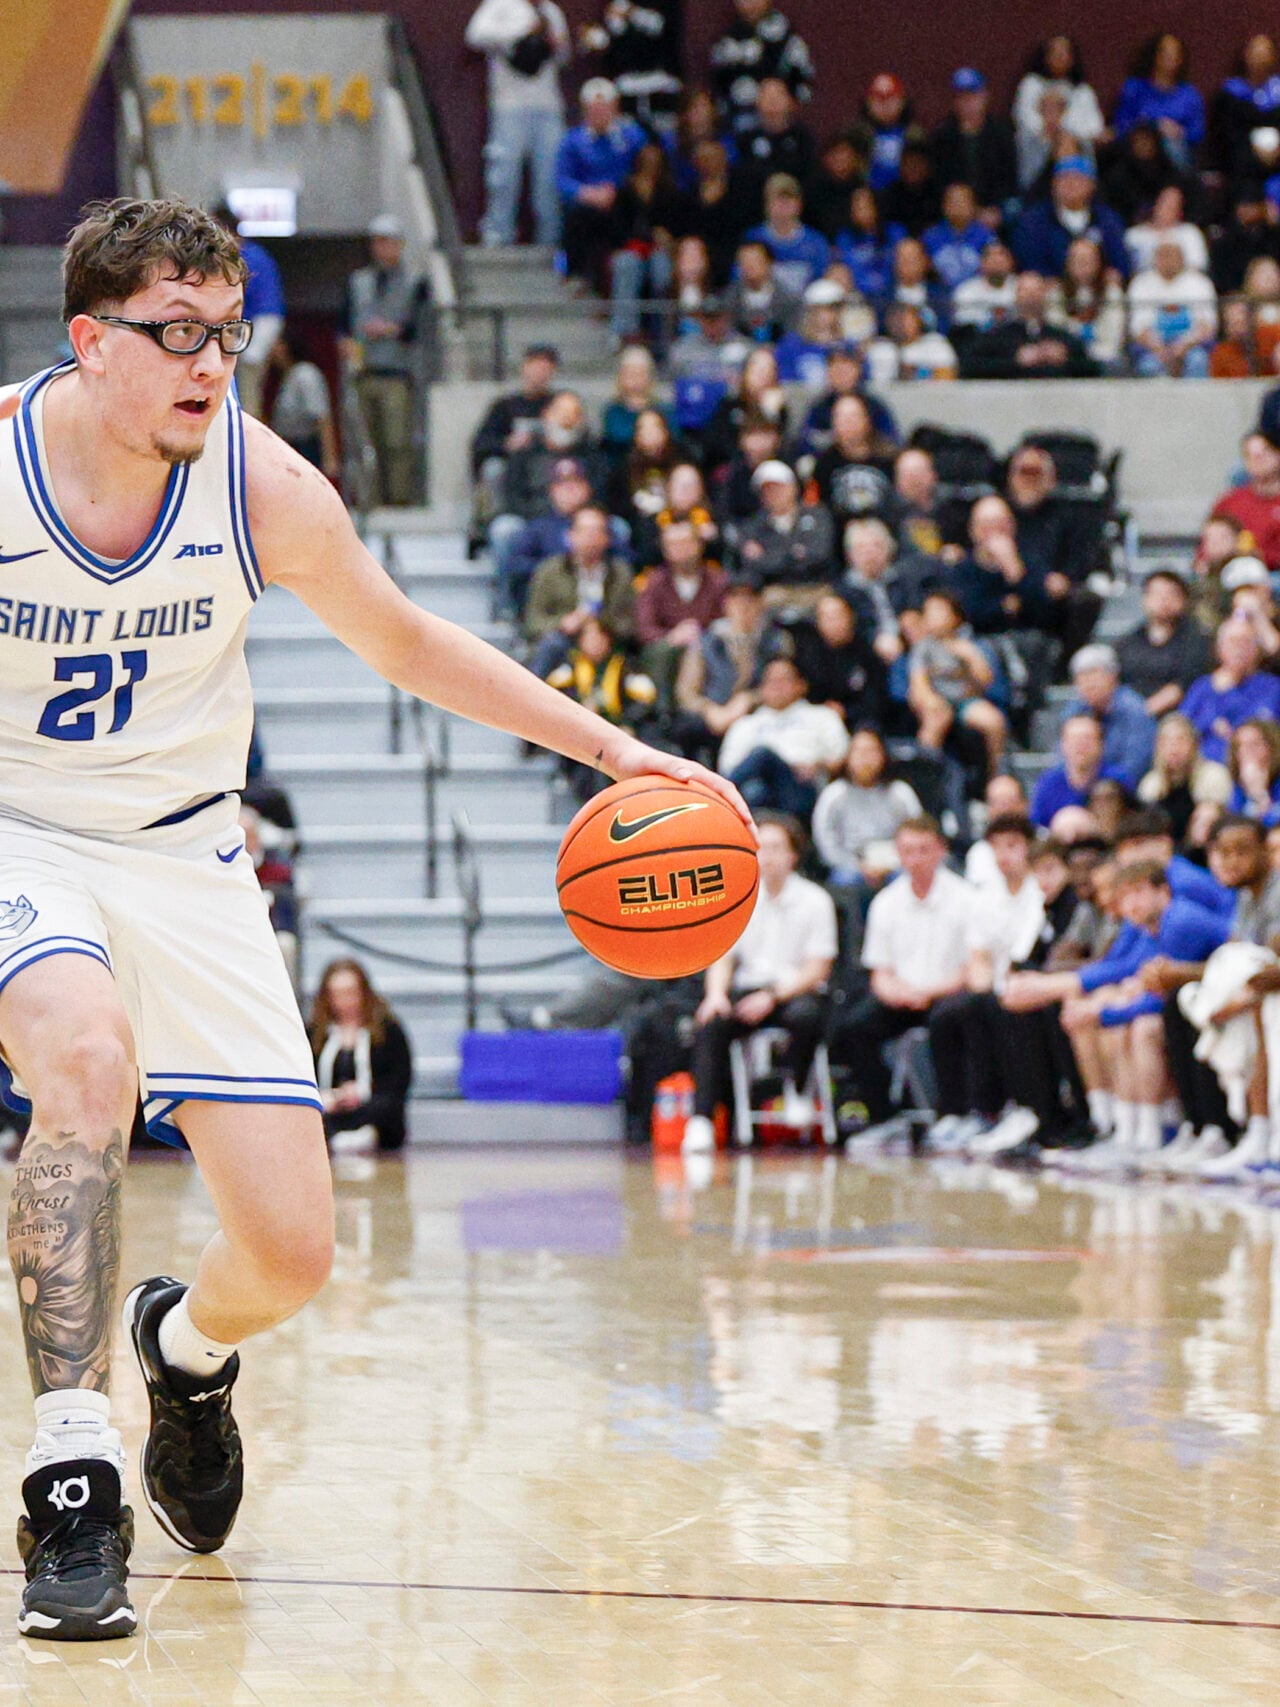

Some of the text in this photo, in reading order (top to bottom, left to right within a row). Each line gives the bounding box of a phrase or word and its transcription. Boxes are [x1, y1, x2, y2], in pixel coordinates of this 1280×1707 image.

[148, 74, 372, 124] 212 214
[173, 543, 223, 560] A10
[110, 594, 215, 641] LOUIS
[36, 649, 147, 741] 21
[618, 863, 724, 904] ELITE
[620, 893, 726, 915] CHAMPIONSHIP
[16, 1164, 73, 1181] THINGS
[18, 1191, 70, 1212] Christ
